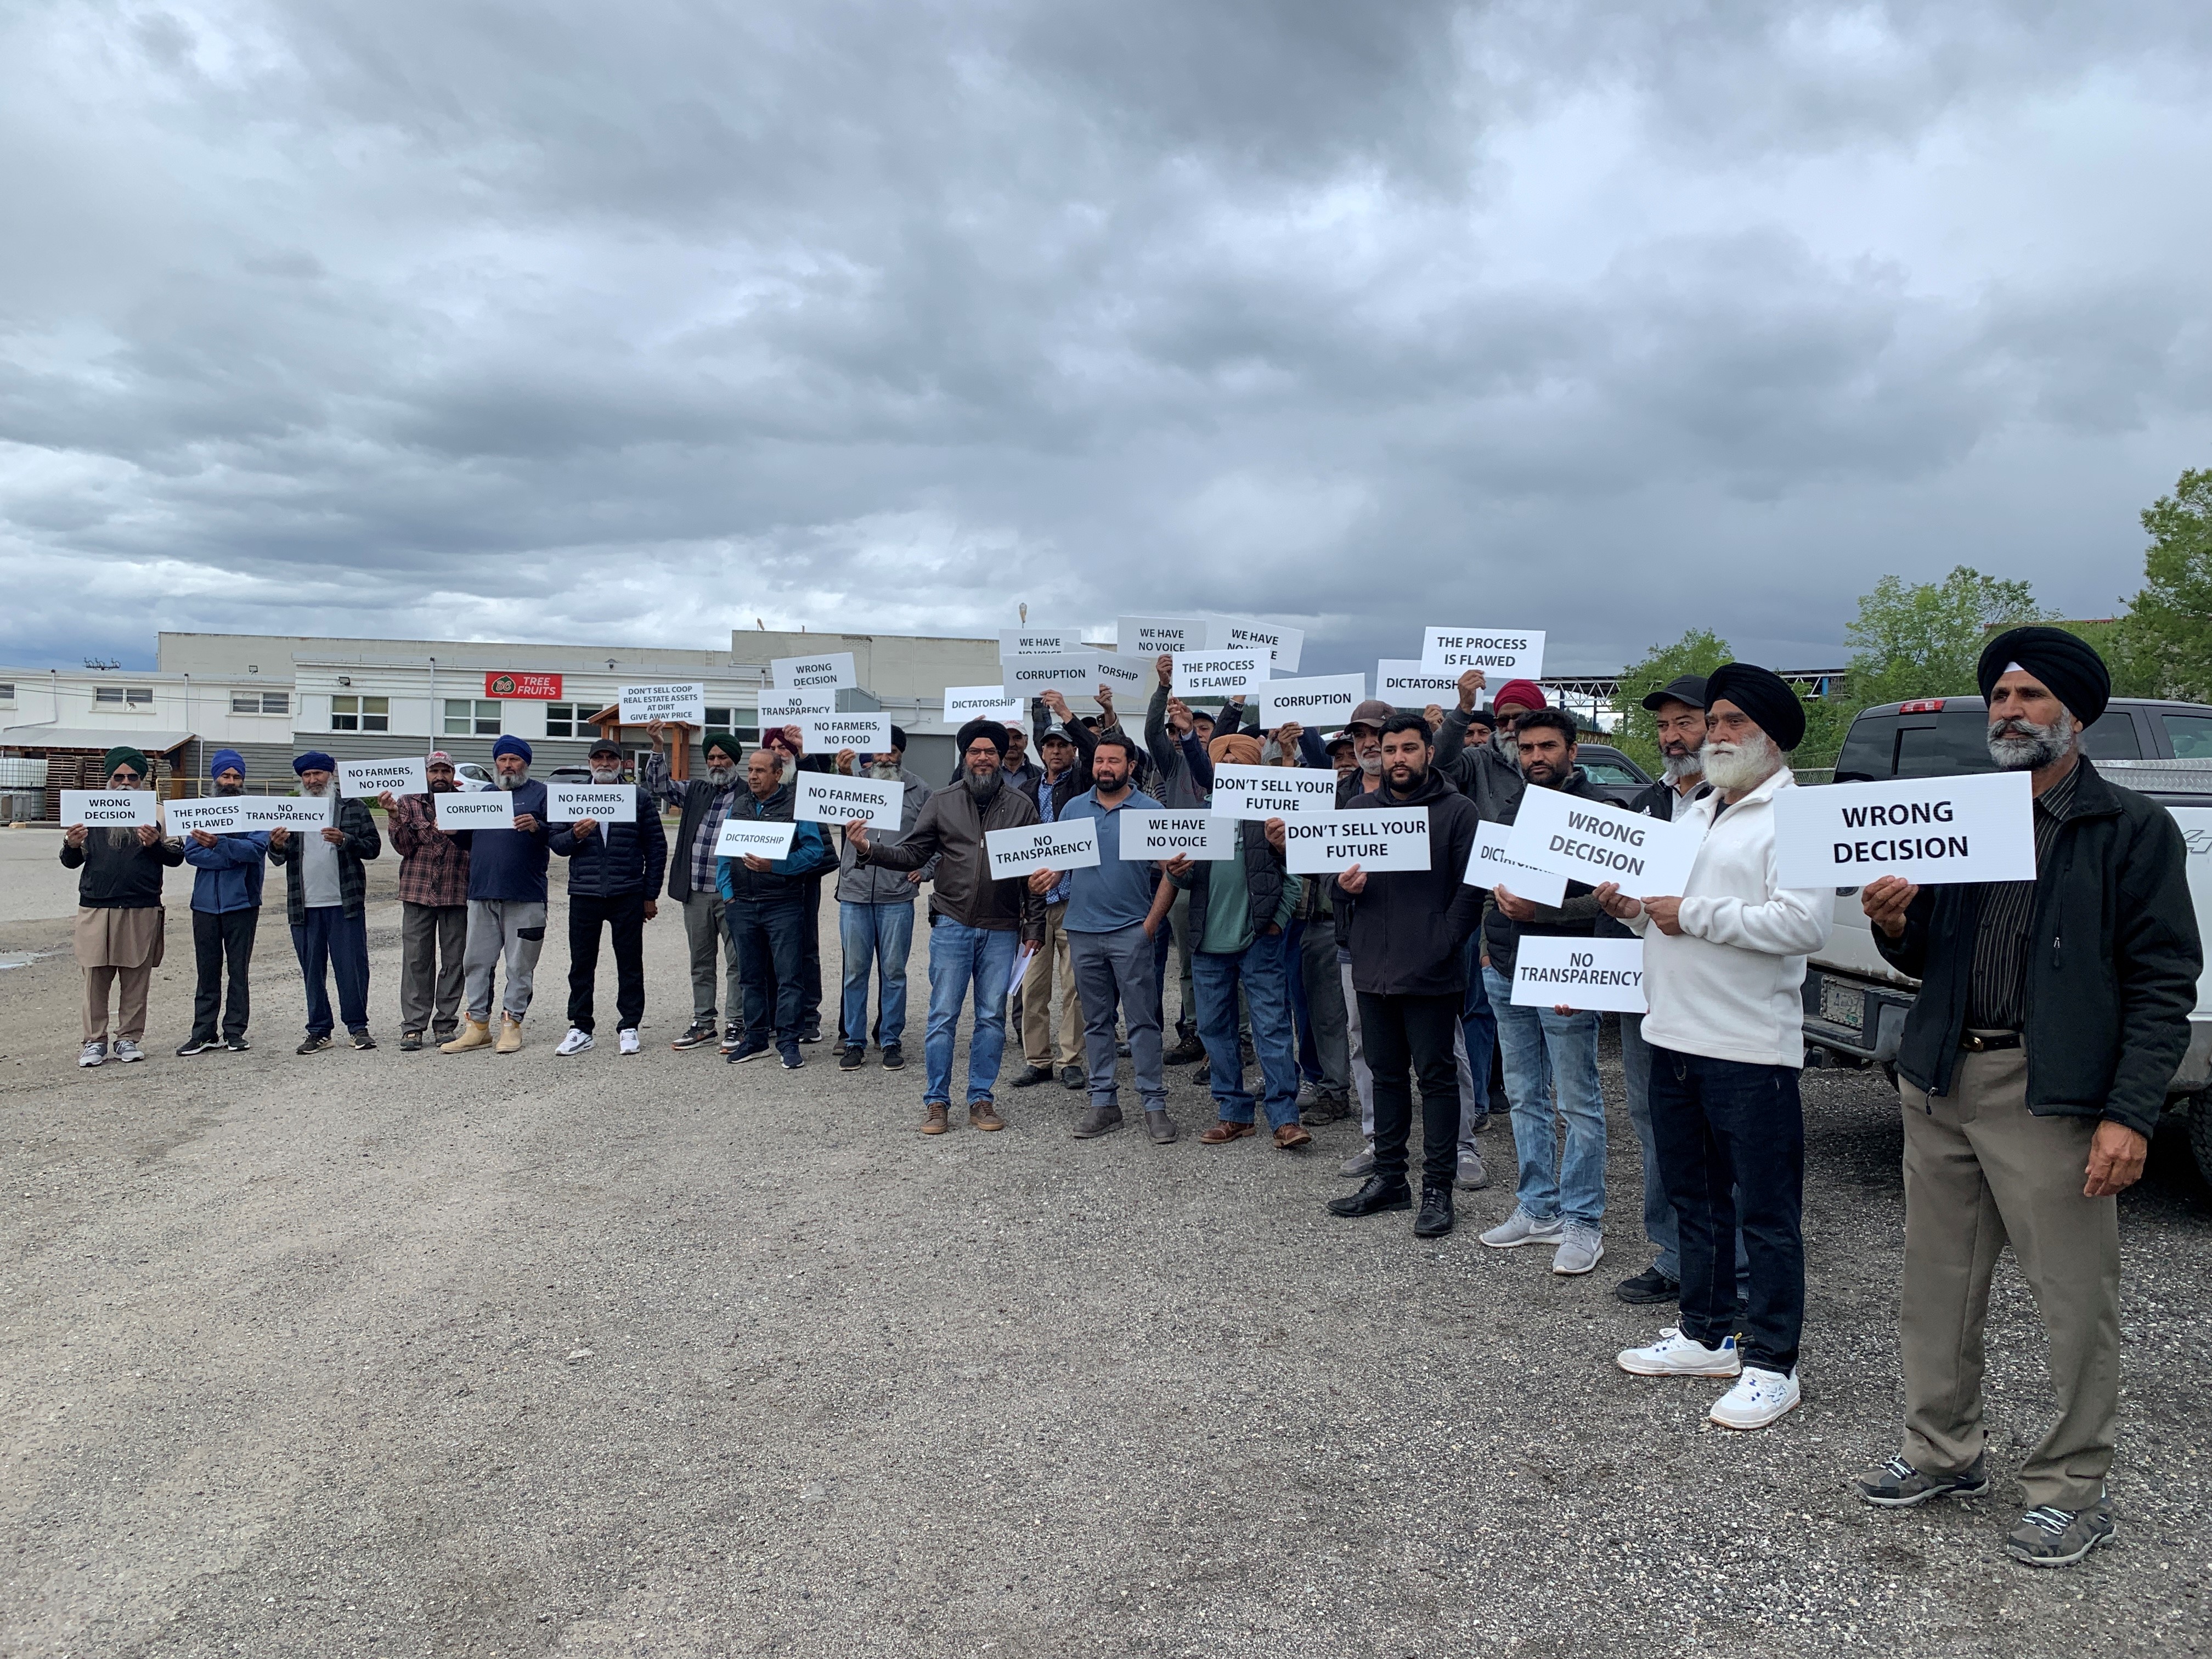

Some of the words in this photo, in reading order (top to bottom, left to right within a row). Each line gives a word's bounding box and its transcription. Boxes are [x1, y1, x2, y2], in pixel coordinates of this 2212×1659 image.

[1140, 629, 1155, 637] WE
[1158, 630, 1183, 638] HAVE
[1232, 629, 1248, 640] WE
[1250, 633, 1278, 645] HAVE
[1139, 642, 1153, 651] NO
[1155, 643, 1184, 651] VOICE
[1437, 637, 1463, 647] THE
[1466, 638, 1527, 650] PROCESS
[1445, 654, 1456, 664] IS
[1460, 655, 1515, 667] FLAWED
[796, 663, 832, 673] WRONG
[1098, 664, 1138, 681] TORSHIP
[1182, 663, 1203, 673] THE
[1206, 661, 1254, 672] PROCESS
[1017, 669, 1085, 679] CORRUPTION
[496, 680, 511, 691] BC
[523, 676, 550, 686] TREE
[794, 675, 837, 686] DECISION
[1190, 679, 1199, 687] IS
[1203, 676, 1246, 687] FLAWED
[1387, 678, 1458, 690] DICTATORSH
[517, 686, 556, 695] FRUITS
[952, 699, 1016, 709] DICTATORSHIP
[1274, 693, 1351, 707] CORRUPTION
[761, 707, 830, 715] TRANSPARENCY
[832, 722, 879, 731] FARMERS,
[825, 736, 839, 744] NO
[366, 767, 413, 776] FARMERS,
[1215, 778, 1258, 790] DON'T
[1262, 780, 1292, 792] SELL
[1296, 782, 1333, 793] YOUR
[809, 787, 826, 798] NO
[830, 790, 887, 806] FARMERS,
[447, 805, 502, 813] CORRUPTION
[1247, 798, 1299, 810] FUTURE
[196, 806, 239, 816] PROCESS
[819, 805, 837, 815] NO
[840, 807, 873, 819] FOOD
[1842, 802, 1953, 827] WRONG
[194, 819, 233, 828] FLAWED
[1149, 820, 1167, 829] WE
[1172, 820, 1205, 830] HAVE
[1568, 811, 1645, 847] WRONG
[1289, 825, 1337, 838] DON'T
[1342, 823, 1378, 836] SELL
[1381, 821, 1425, 834] YOUR
[726, 834, 784, 844] DICTATORSHIP
[1034, 836, 1052, 847] NO
[1148, 837, 1165, 846] NO
[1169, 837, 1206, 847] VOICE
[996, 840, 1092, 864] TRANSPARENCY
[1327, 844, 1387, 857] FUTURE
[1549, 834, 1645, 876] DECISION
[1834, 836, 1968, 863] DECISION
[1570, 953, 1593, 967] NO
[1521, 967, 1643, 986] TRANSPARENCY
